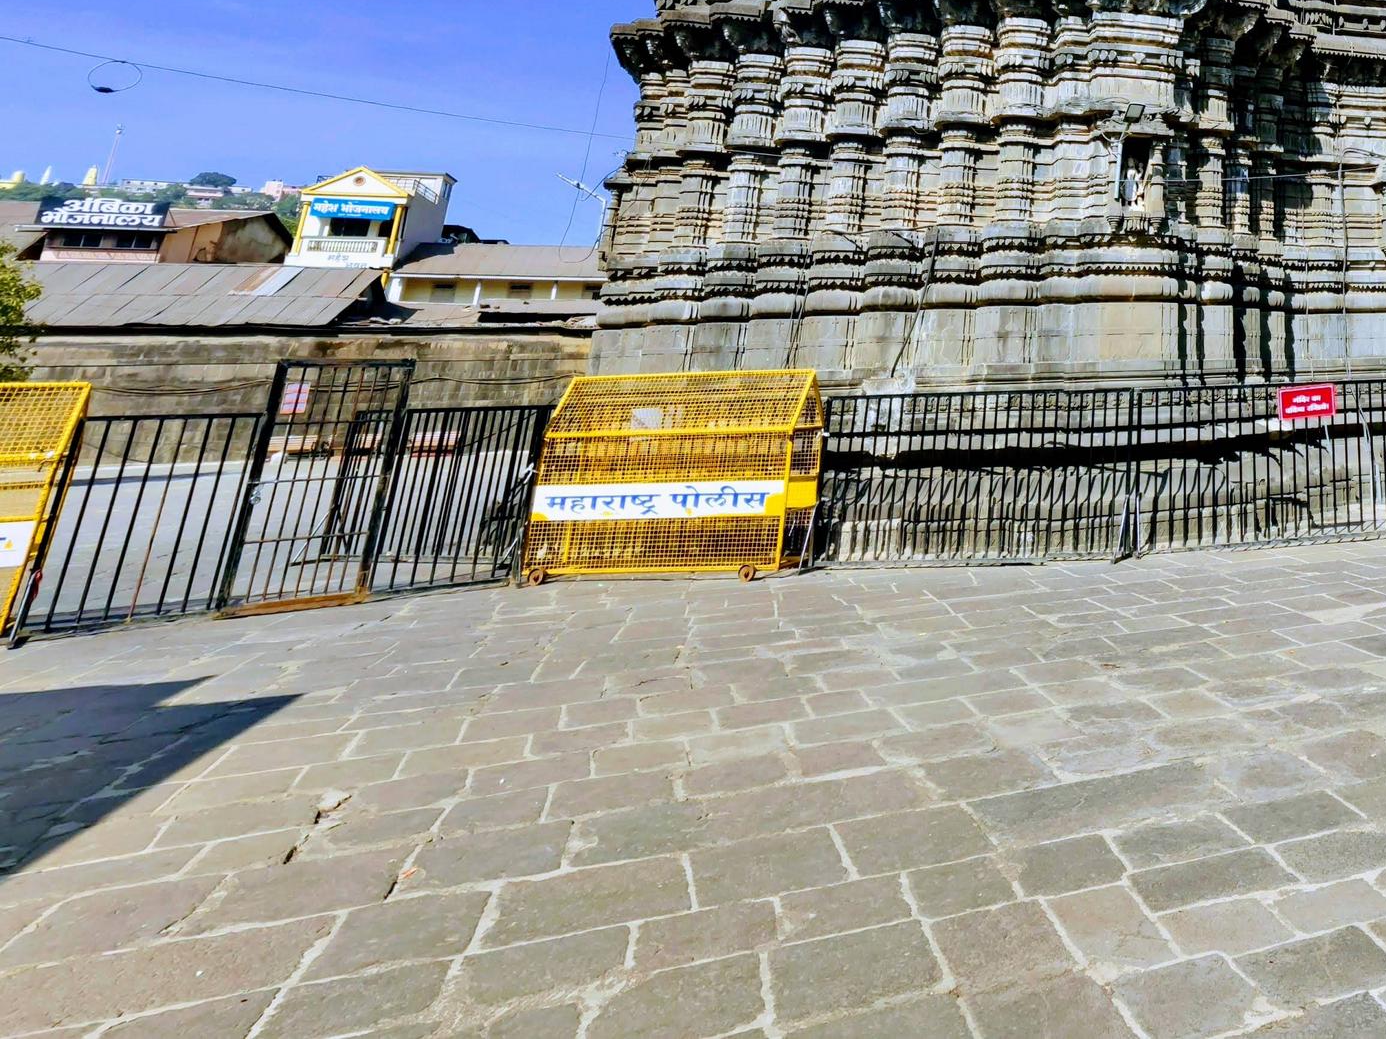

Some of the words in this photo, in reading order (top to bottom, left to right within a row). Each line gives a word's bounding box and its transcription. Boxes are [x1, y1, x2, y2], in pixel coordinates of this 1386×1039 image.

[63, 198, 155, 215] अंबिका
[313, 200, 339, 213] महेश
[341, 201, 390, 215] भोजनालय
[40, 207, 163, 227] भोजनालय
[545, 493, 661, 515] महाराष्ट्र
[668, 485, 771, 509] पोलीस
